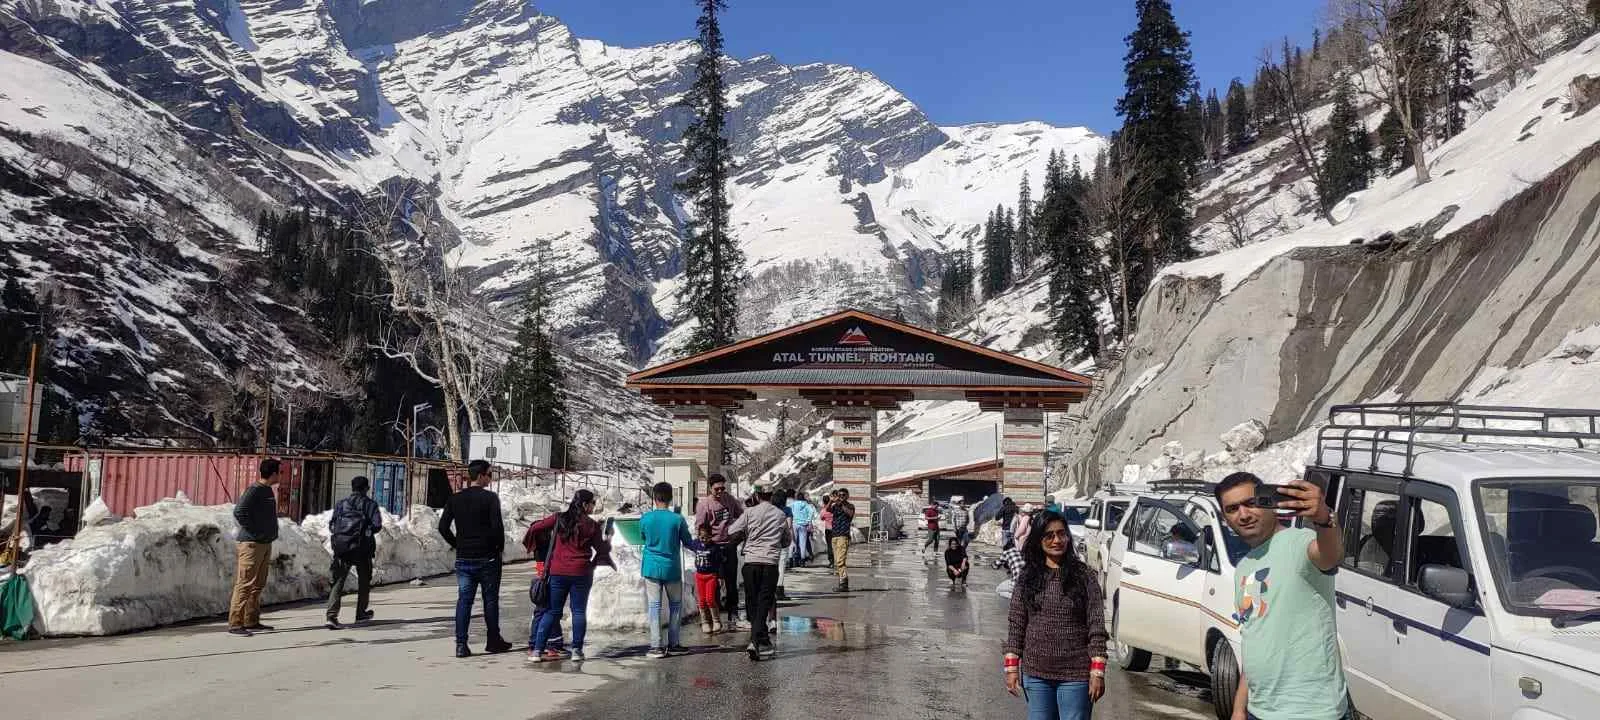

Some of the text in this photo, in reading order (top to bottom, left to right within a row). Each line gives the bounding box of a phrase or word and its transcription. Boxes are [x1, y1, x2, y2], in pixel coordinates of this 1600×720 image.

[772, 352, 935, 364] ATAL TUNNEL, ROHTANG
